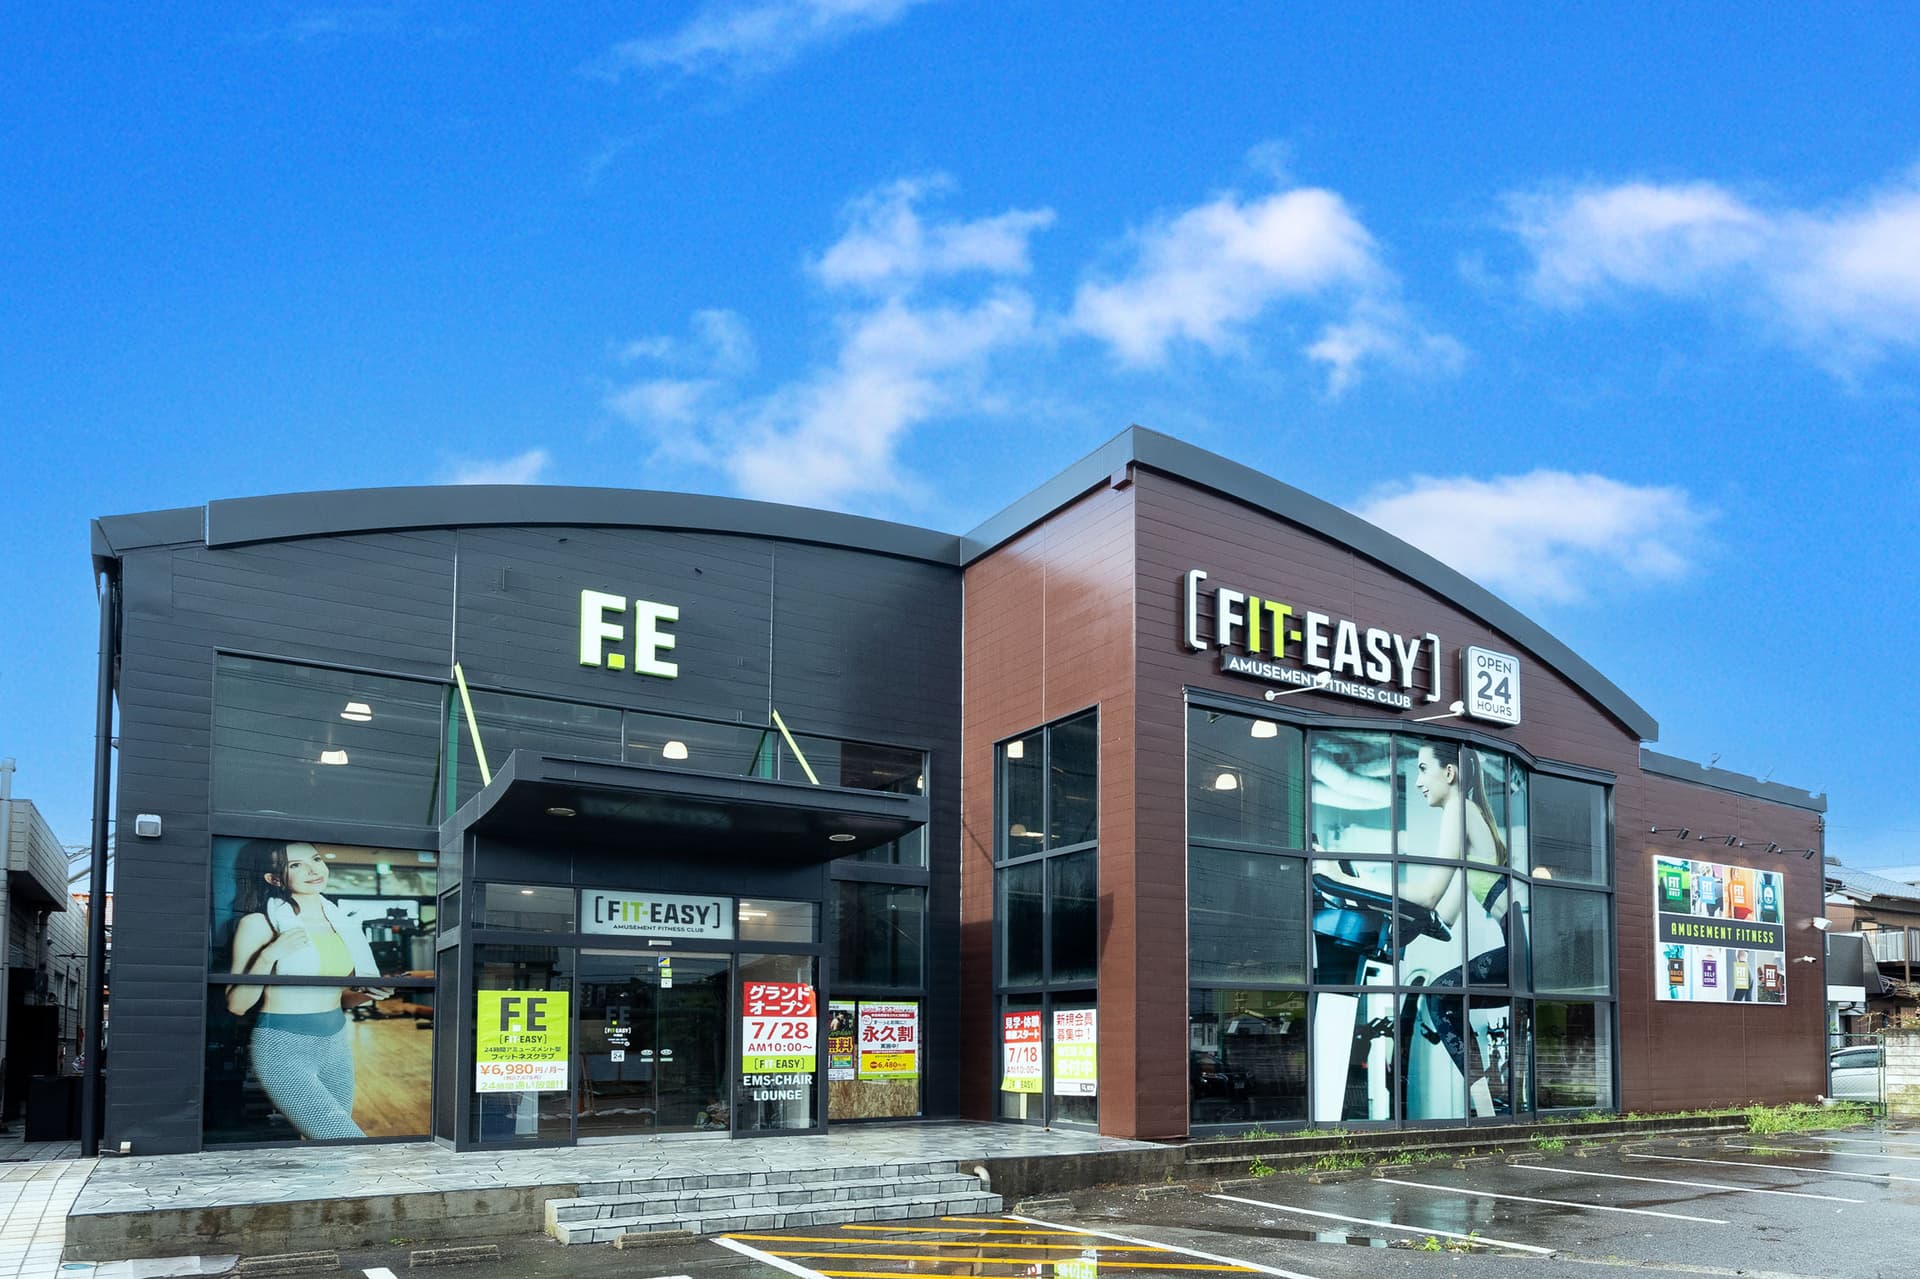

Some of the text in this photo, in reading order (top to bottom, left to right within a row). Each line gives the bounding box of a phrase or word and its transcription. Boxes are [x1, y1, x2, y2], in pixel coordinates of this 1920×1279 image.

[580, 589, 680, 679] F.E
[1477, 655, 1512, 674] OPEN
[1229, 656, 1412, 709] AMUSEMENT ITNESS CLUB
[1477, 670, 1512, 705] 24
[1477, 700, 1513, 717] HOURS
[1668, 876, 1680, 889] FIT
[1702, 880, 1713, 891] FIT
[1733, 884, 1745, 896] FIT
[1671, 922, 1775, 944] AMUSEMENT FITNESS
[1765, 968, 1776, 980] FIT
[749, 985, 813, 1001] グランド
[500, 997, 548, 1032] F.E
[749, 1000, 812, 1016] オープン
[751, 1022, 809, 1040] 7/28
[862, 1025, 914, 1043] 永久割
[1005, 1029, 1040, 1040] スタート
[491, 1053, 555, 1061] フィットネスクラブ
[1008, 1046, 1038, 1063] 7/18
[743, 1074, 813, 1086] EMS-CHAIR
[753, 1089, 803, 1102] LOUNGE
